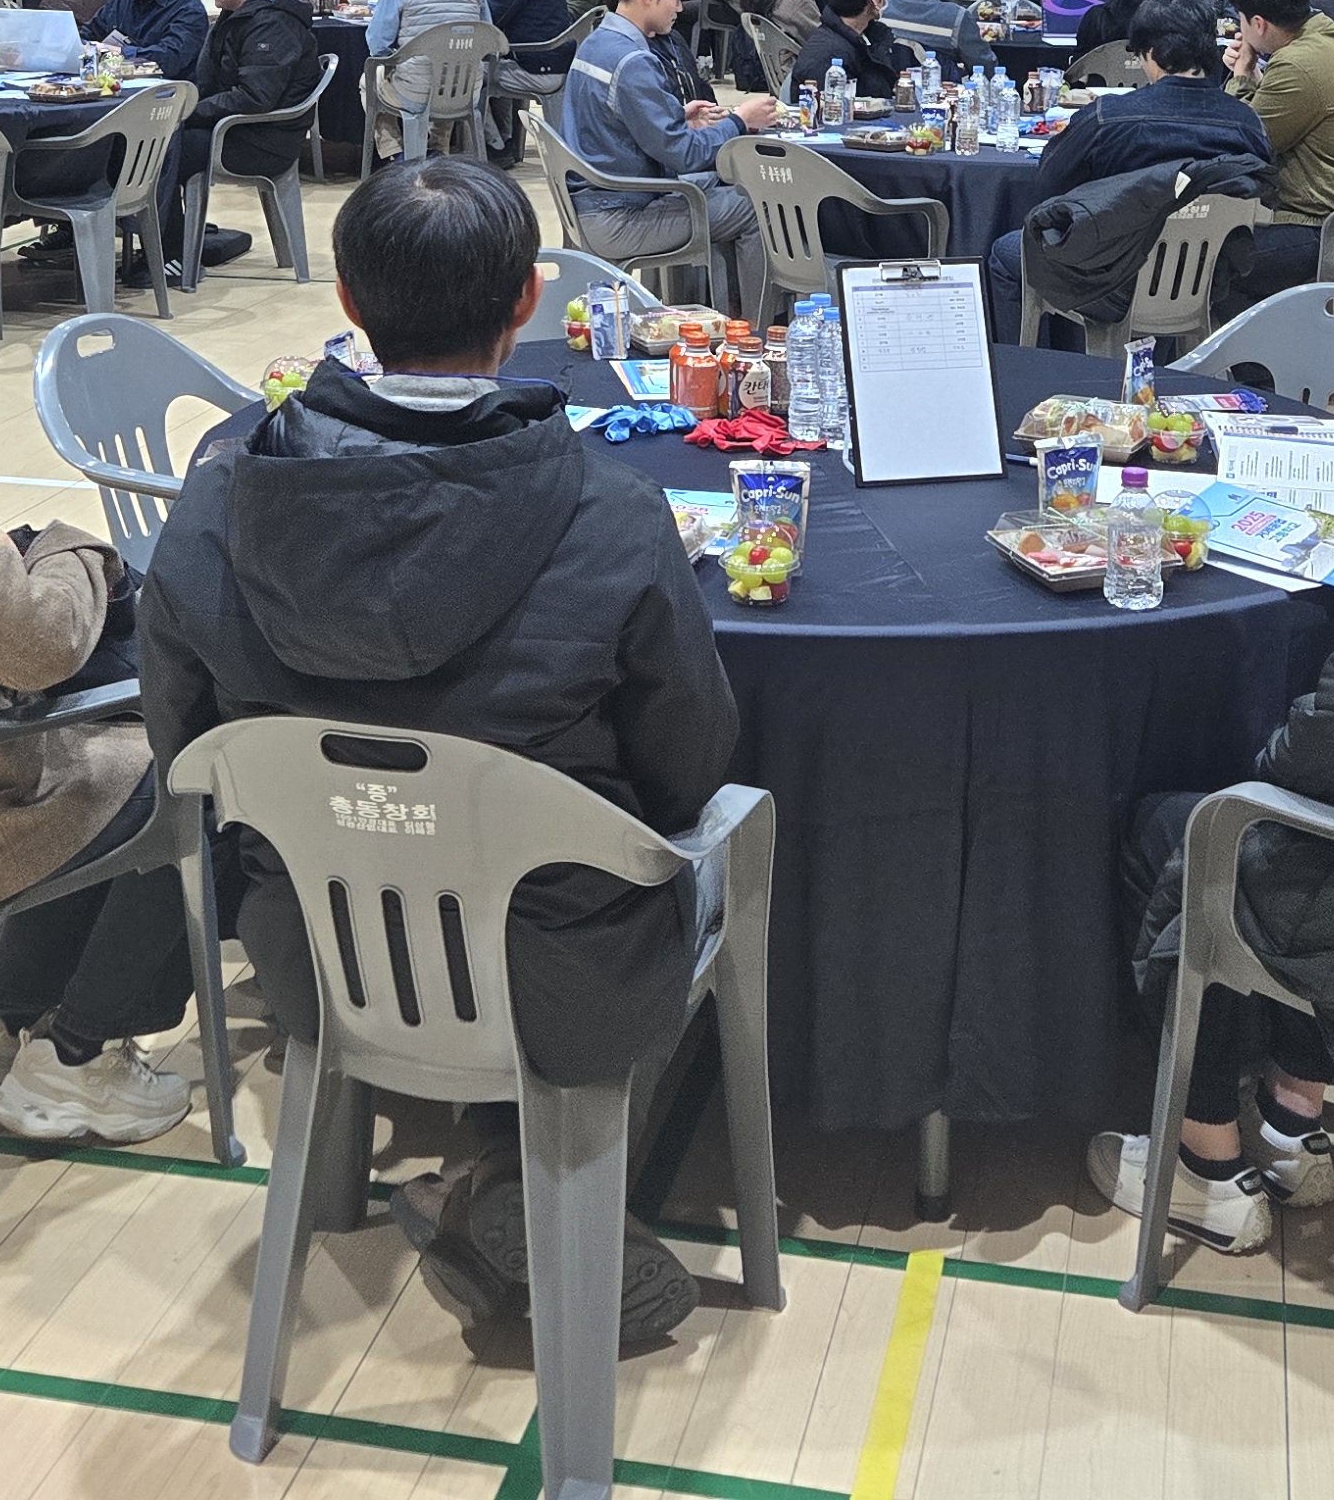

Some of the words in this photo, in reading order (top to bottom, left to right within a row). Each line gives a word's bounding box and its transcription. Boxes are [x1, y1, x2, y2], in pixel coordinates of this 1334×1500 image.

[740, 484, 801, 503] Capri-Sun
[1230, 510, 1266, 533] 2025
[329, 795, 437, 822] 총동창회
